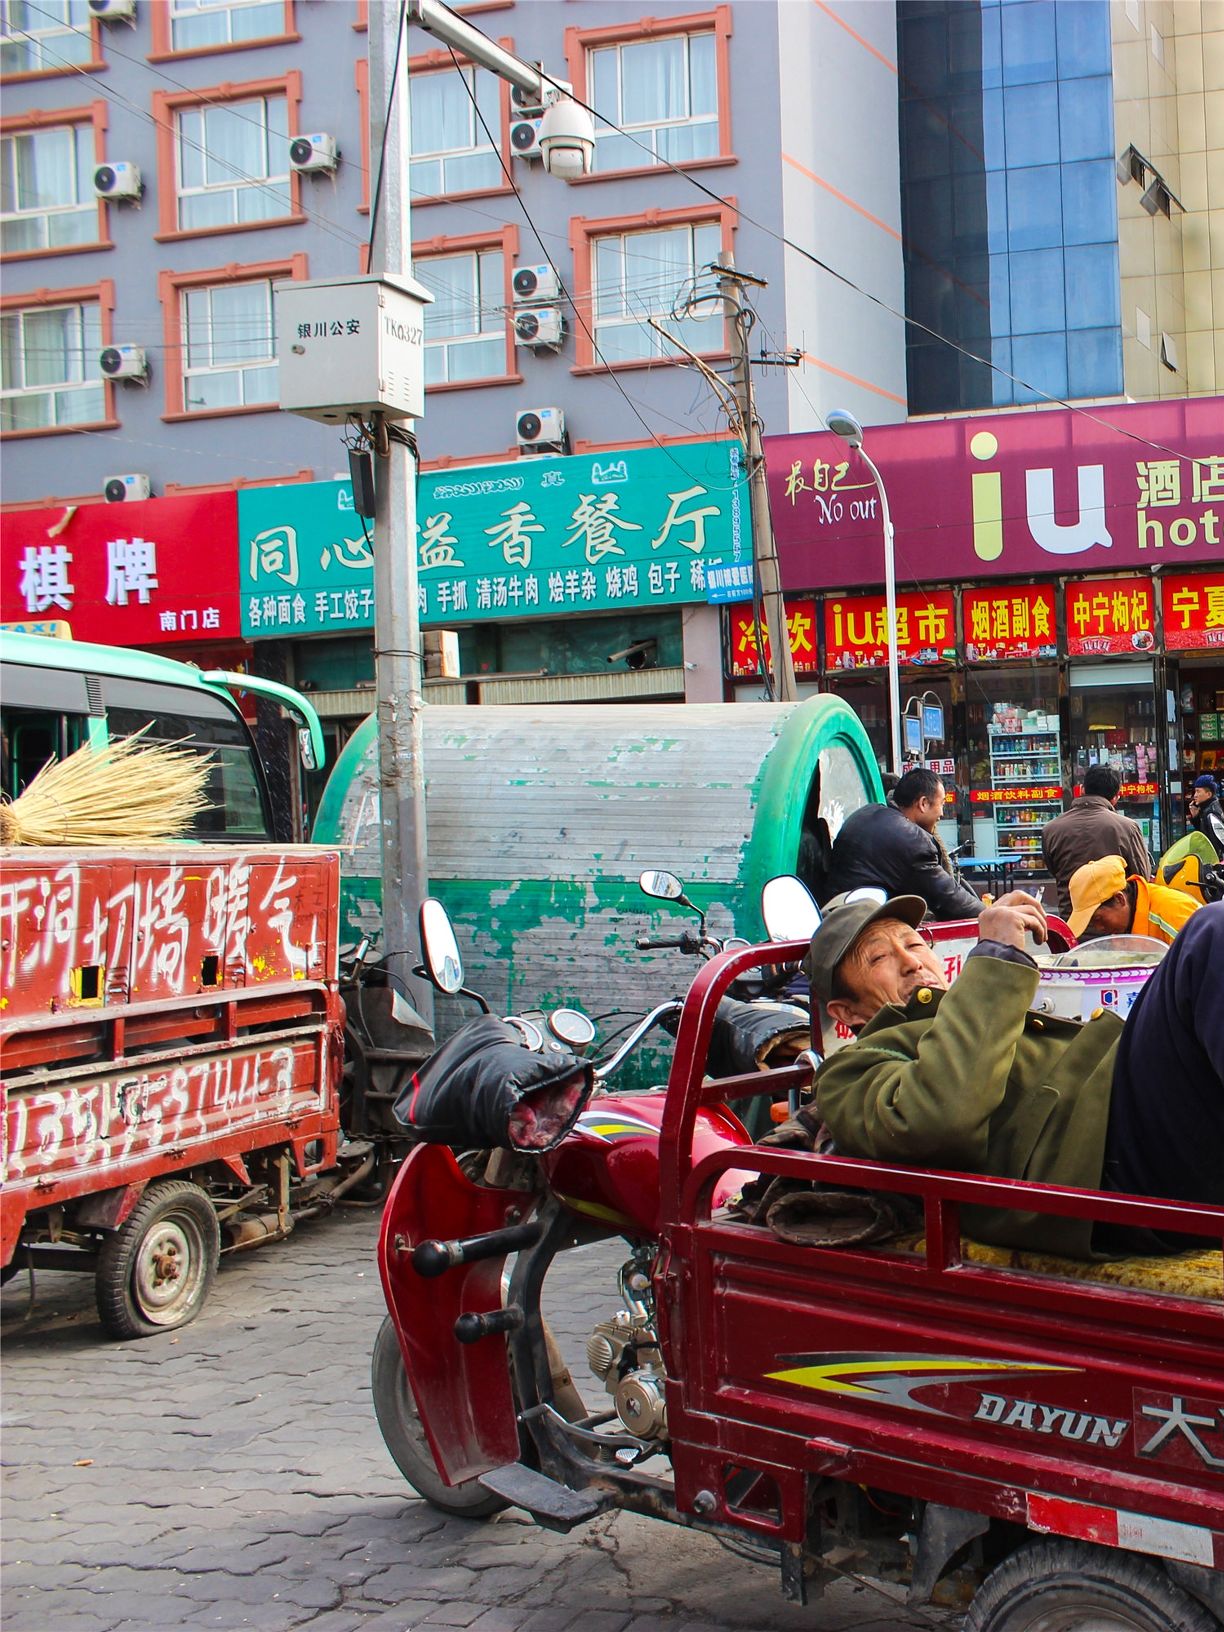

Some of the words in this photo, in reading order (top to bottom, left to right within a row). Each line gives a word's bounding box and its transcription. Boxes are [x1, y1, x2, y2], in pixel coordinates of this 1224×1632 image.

[298, 319, 360, 339] 银川公安
[815, 494, 843, 524] No
[850, 497, 876, 520] out
[970, 431, 1113, 562] iu
[18, 537, 159, 613] 棋牌
[249, 594, 306, 628] 各种面食
[315, 580, 375, 622] 手工饺子
[437, 580, 468, 612] 手抓
[476, 573, 539, 610] 清汤牛肉
[548, 568, 597, 603] 烩羊杂
[606, 564, 639, 599] 烧鸡
[648, 561, 680, 594] 包子
[159, 608, 220, 631] 南门店
[971, 595, 1051, 641] 烟酒副食
[1074, 589, 1150, 635] 中宁枸杞
[976, 788, 1059, 801] 烟酒饮料副食
[975, 1392, 1128, 1448] DAYUN
